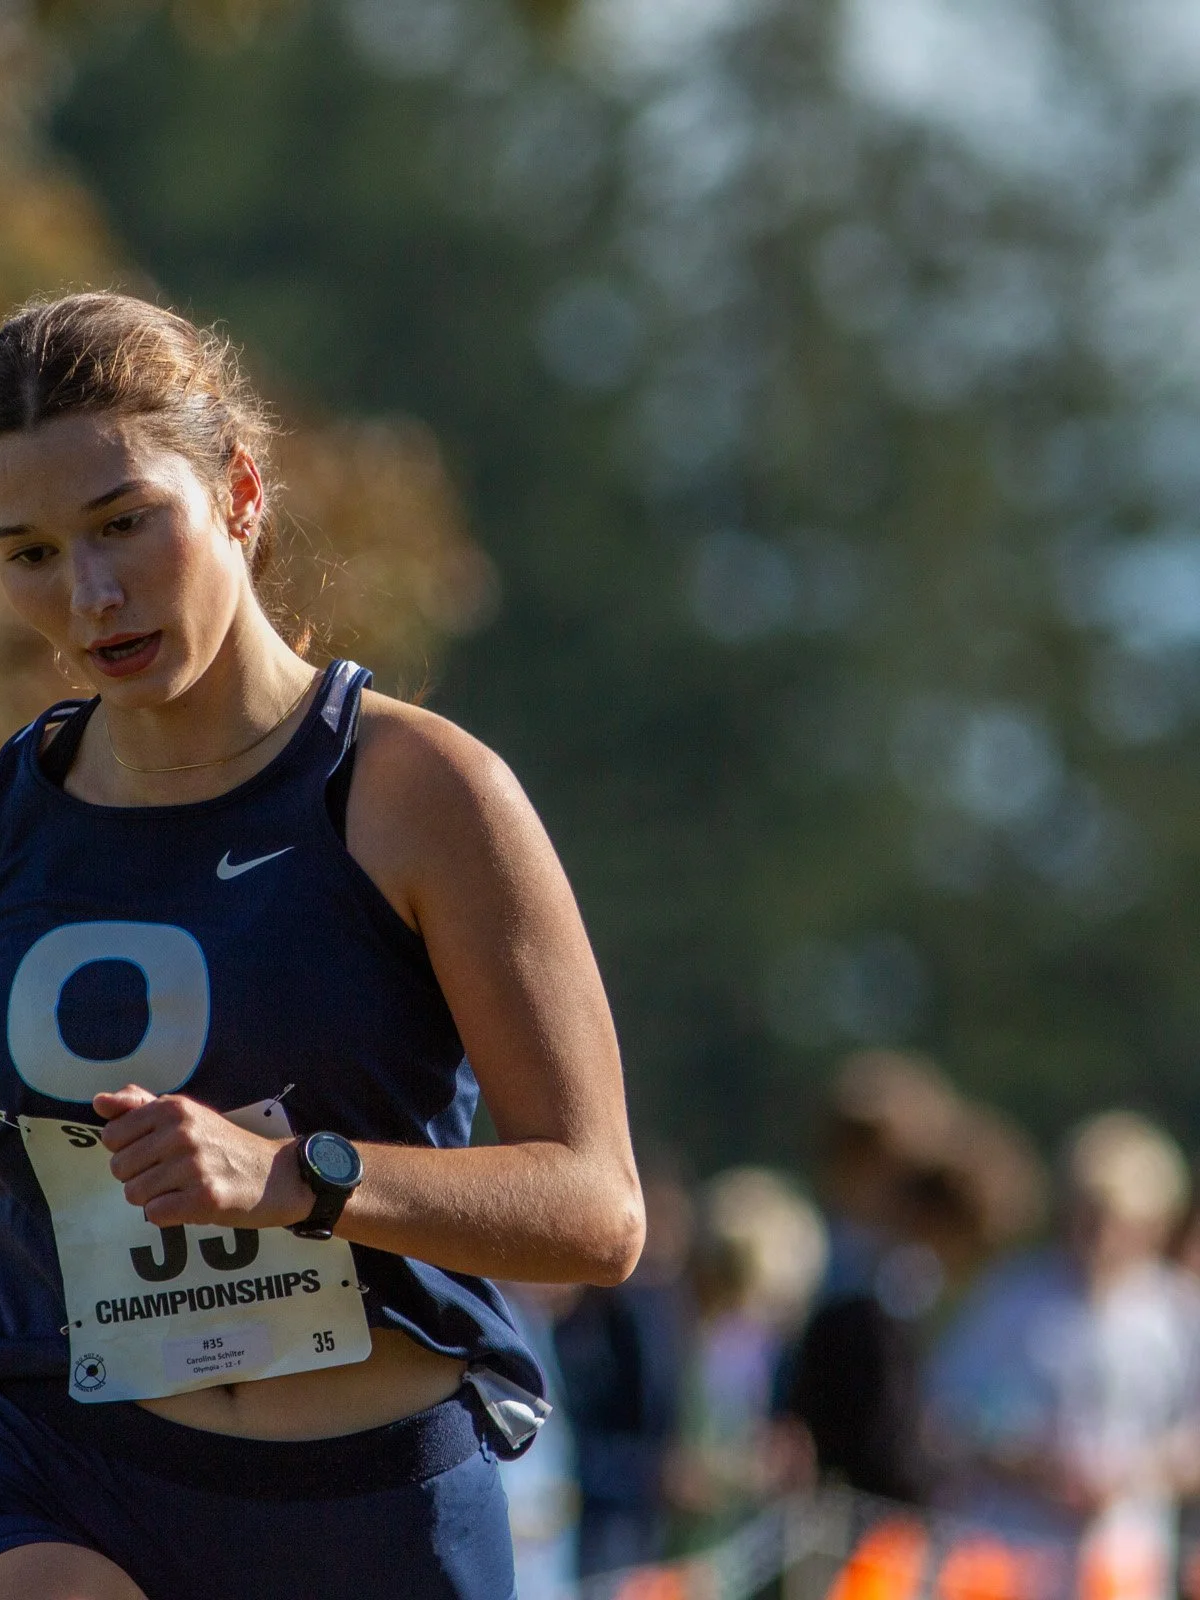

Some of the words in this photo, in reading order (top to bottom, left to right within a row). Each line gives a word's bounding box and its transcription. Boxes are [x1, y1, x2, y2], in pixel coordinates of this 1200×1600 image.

[8, 920, 211, 1102] O
[95, 1269, 321, 1325] CHAMPIONSHIPS
[202, 1337, 224, 1350] #35
[312, 1331, 335, 1353] 35
[186, 1355, 217, 1365] Carolina
[217, 1350, 245, 1360] Schilter
[193, 1363, 220, 1374] Olympia
[225, 1361, 233, 1369] 12
